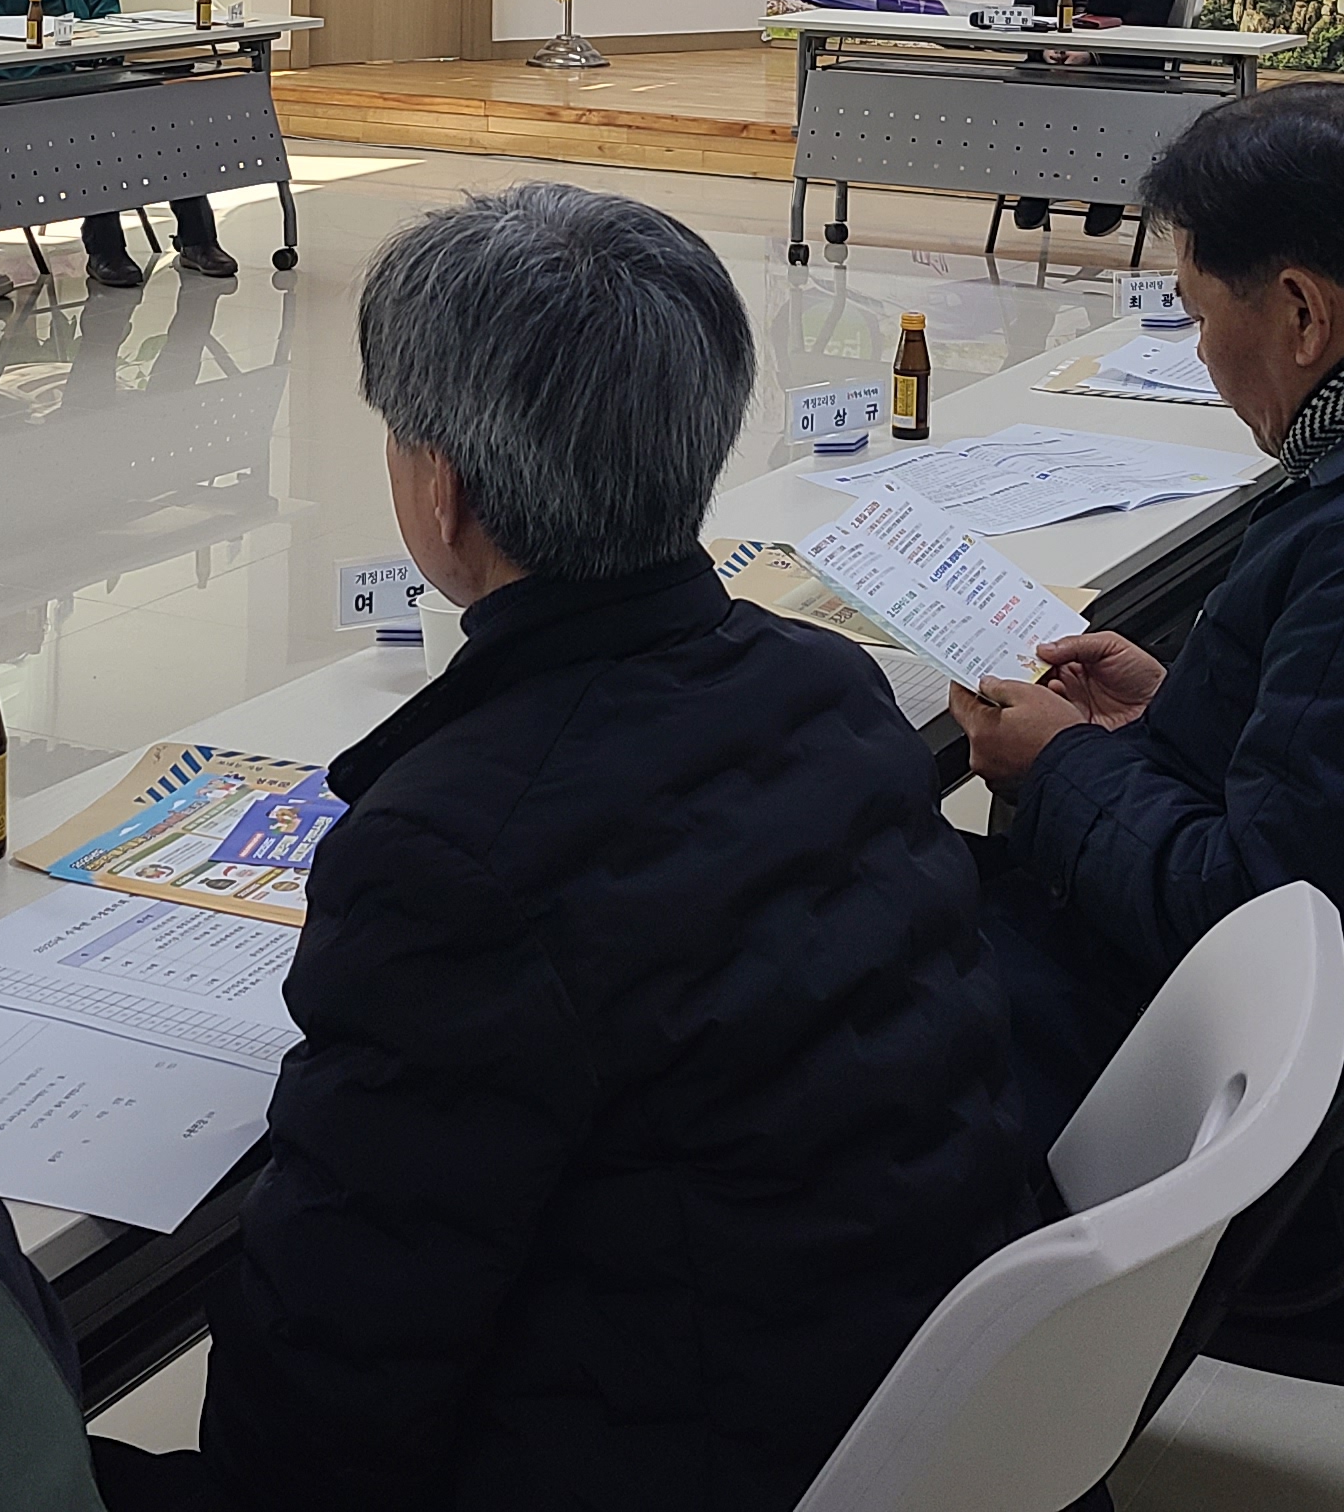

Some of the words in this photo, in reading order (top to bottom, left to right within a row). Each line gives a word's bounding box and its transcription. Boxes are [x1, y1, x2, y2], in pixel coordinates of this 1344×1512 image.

[1128, 294, 1142, 310] 최
[1160, 292, 1175, 308] 광
[801, 413, 815, 432] 이
[833, 407, 848, 427] 상
[864, 402, 879, 422] 규
[355, 566, 409, 586] 계정1리장
[354, 590, 374, 615] 여
